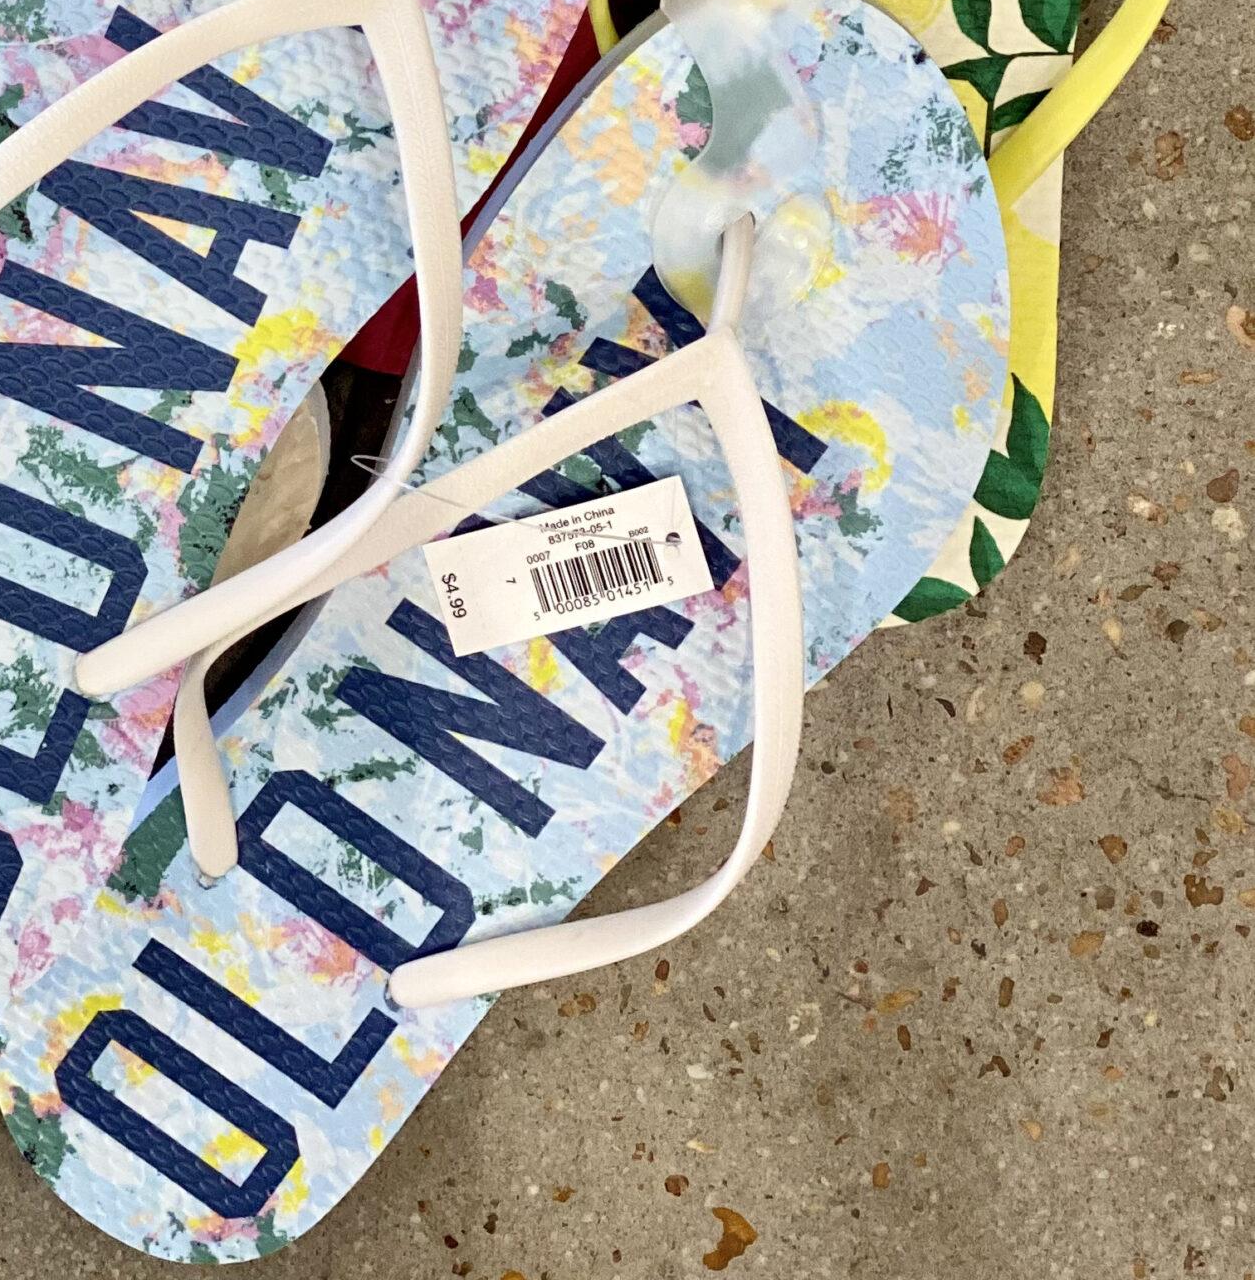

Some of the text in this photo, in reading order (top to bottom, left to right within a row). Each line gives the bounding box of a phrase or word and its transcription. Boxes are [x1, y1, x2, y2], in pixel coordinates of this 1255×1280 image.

[539, 507, 615, 533] Made in China
[628, 526, 649, 538] B002
[526, 551, 551, 565] 0007
[575, 539, 595, 552] F08
[441, 573, 467, 619] $4.99
[556, 594, 601, 615] 00085
[606, 581, 651, 602] 01451
[55, 769, 475, 1218] OLD
